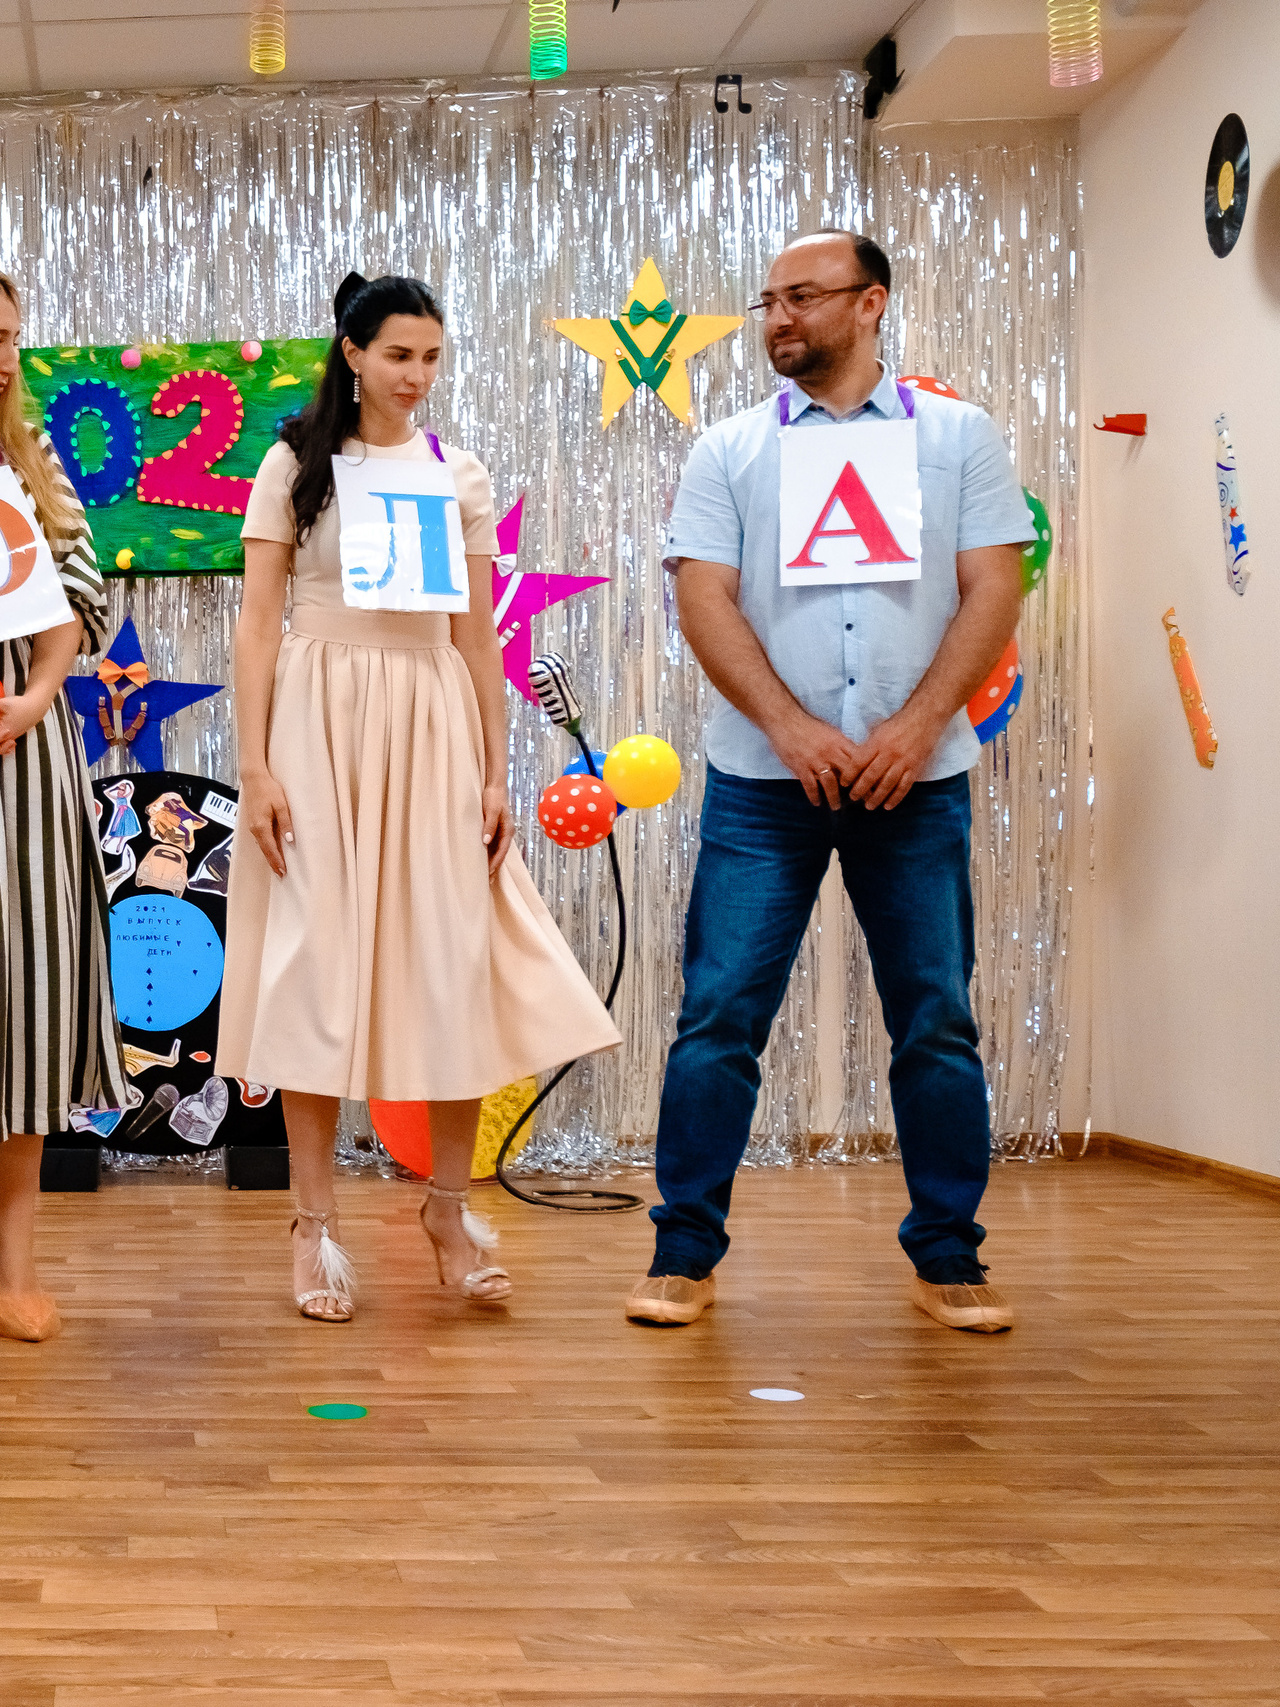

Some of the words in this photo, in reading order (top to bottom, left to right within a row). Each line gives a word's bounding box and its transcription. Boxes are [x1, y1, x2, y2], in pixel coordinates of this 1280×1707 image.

[44, 368, 302, 515] 02
[786, 460, 918, 569] А
[348, 491, 464, 596] Л
[116, 934, 170, 942] ЛЮБИМЫЕ
[127, 918, 182, 926] ВЫПУСК
[147, 948, 172, 957] ДЕТИ
